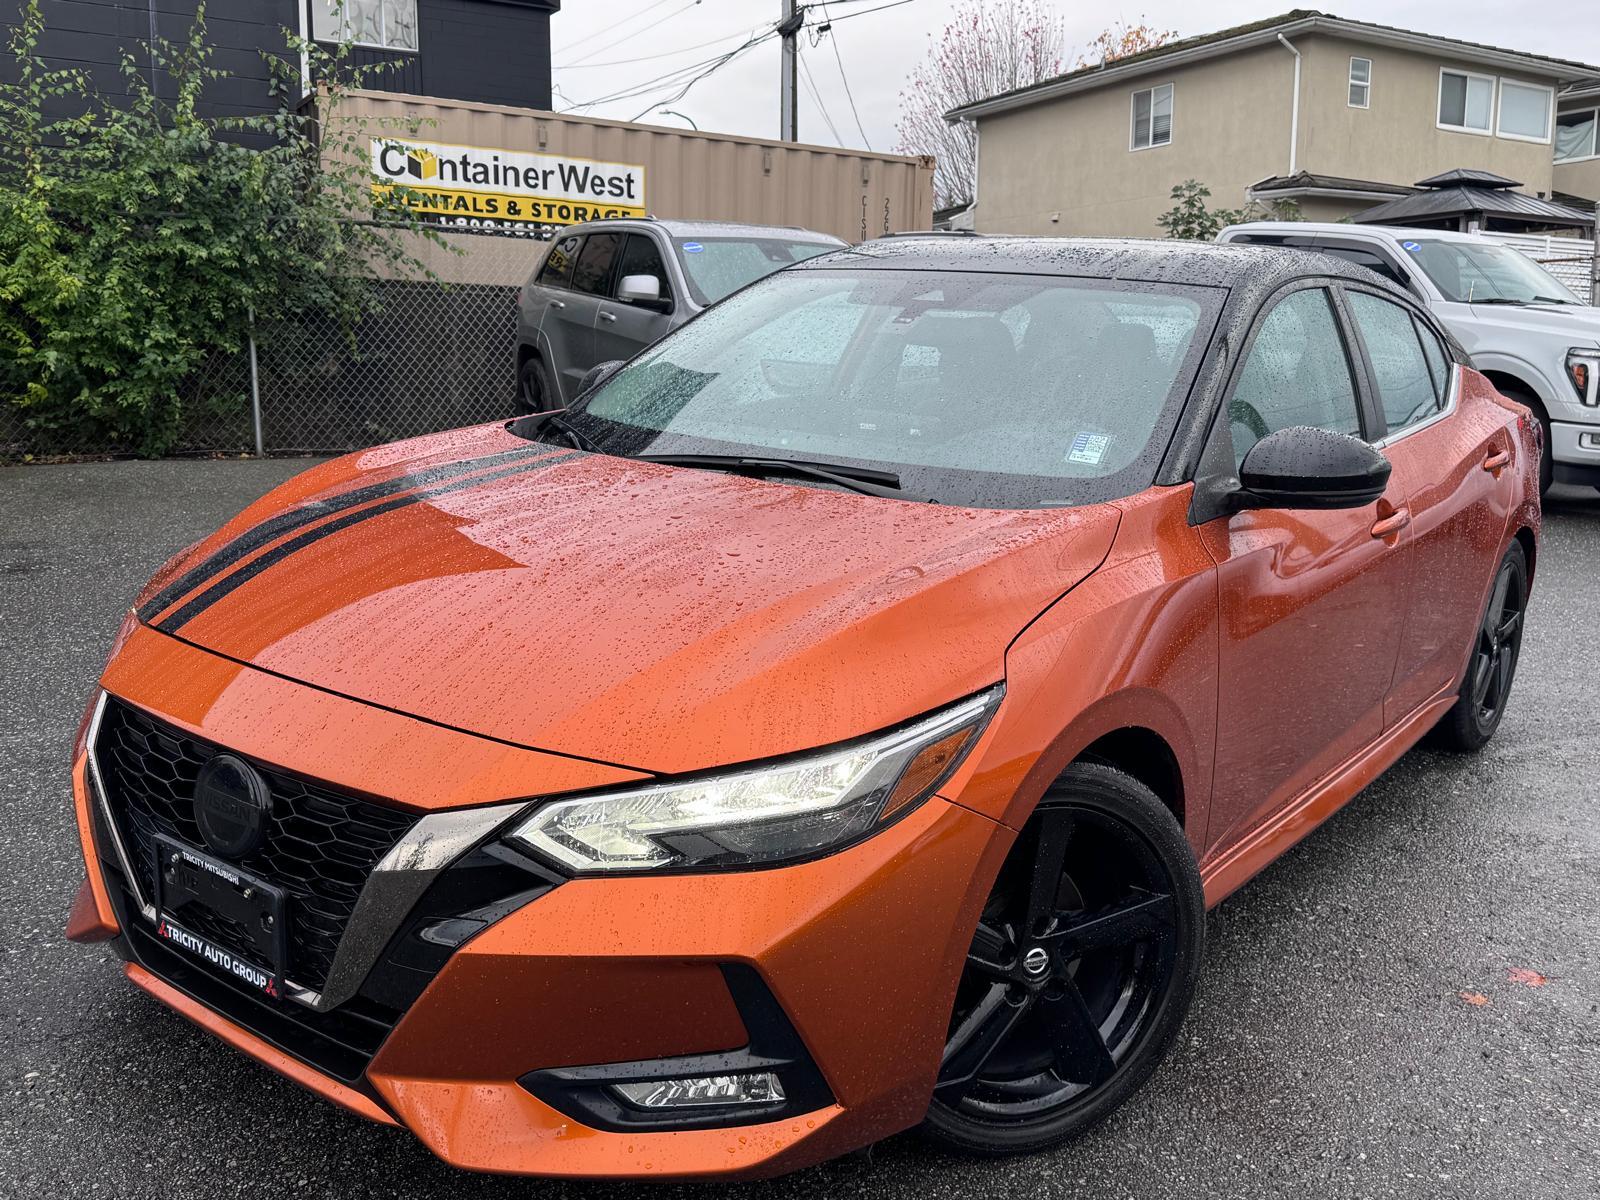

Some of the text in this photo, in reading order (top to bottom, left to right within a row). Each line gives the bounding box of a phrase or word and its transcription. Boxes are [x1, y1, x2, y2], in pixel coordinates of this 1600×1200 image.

[507, 201, 522, 216] &
[182, 851, 239, 886] TRICITY MITSUBISHI
[167, 925, 267, 988] TRICITY AUTO GROUP
